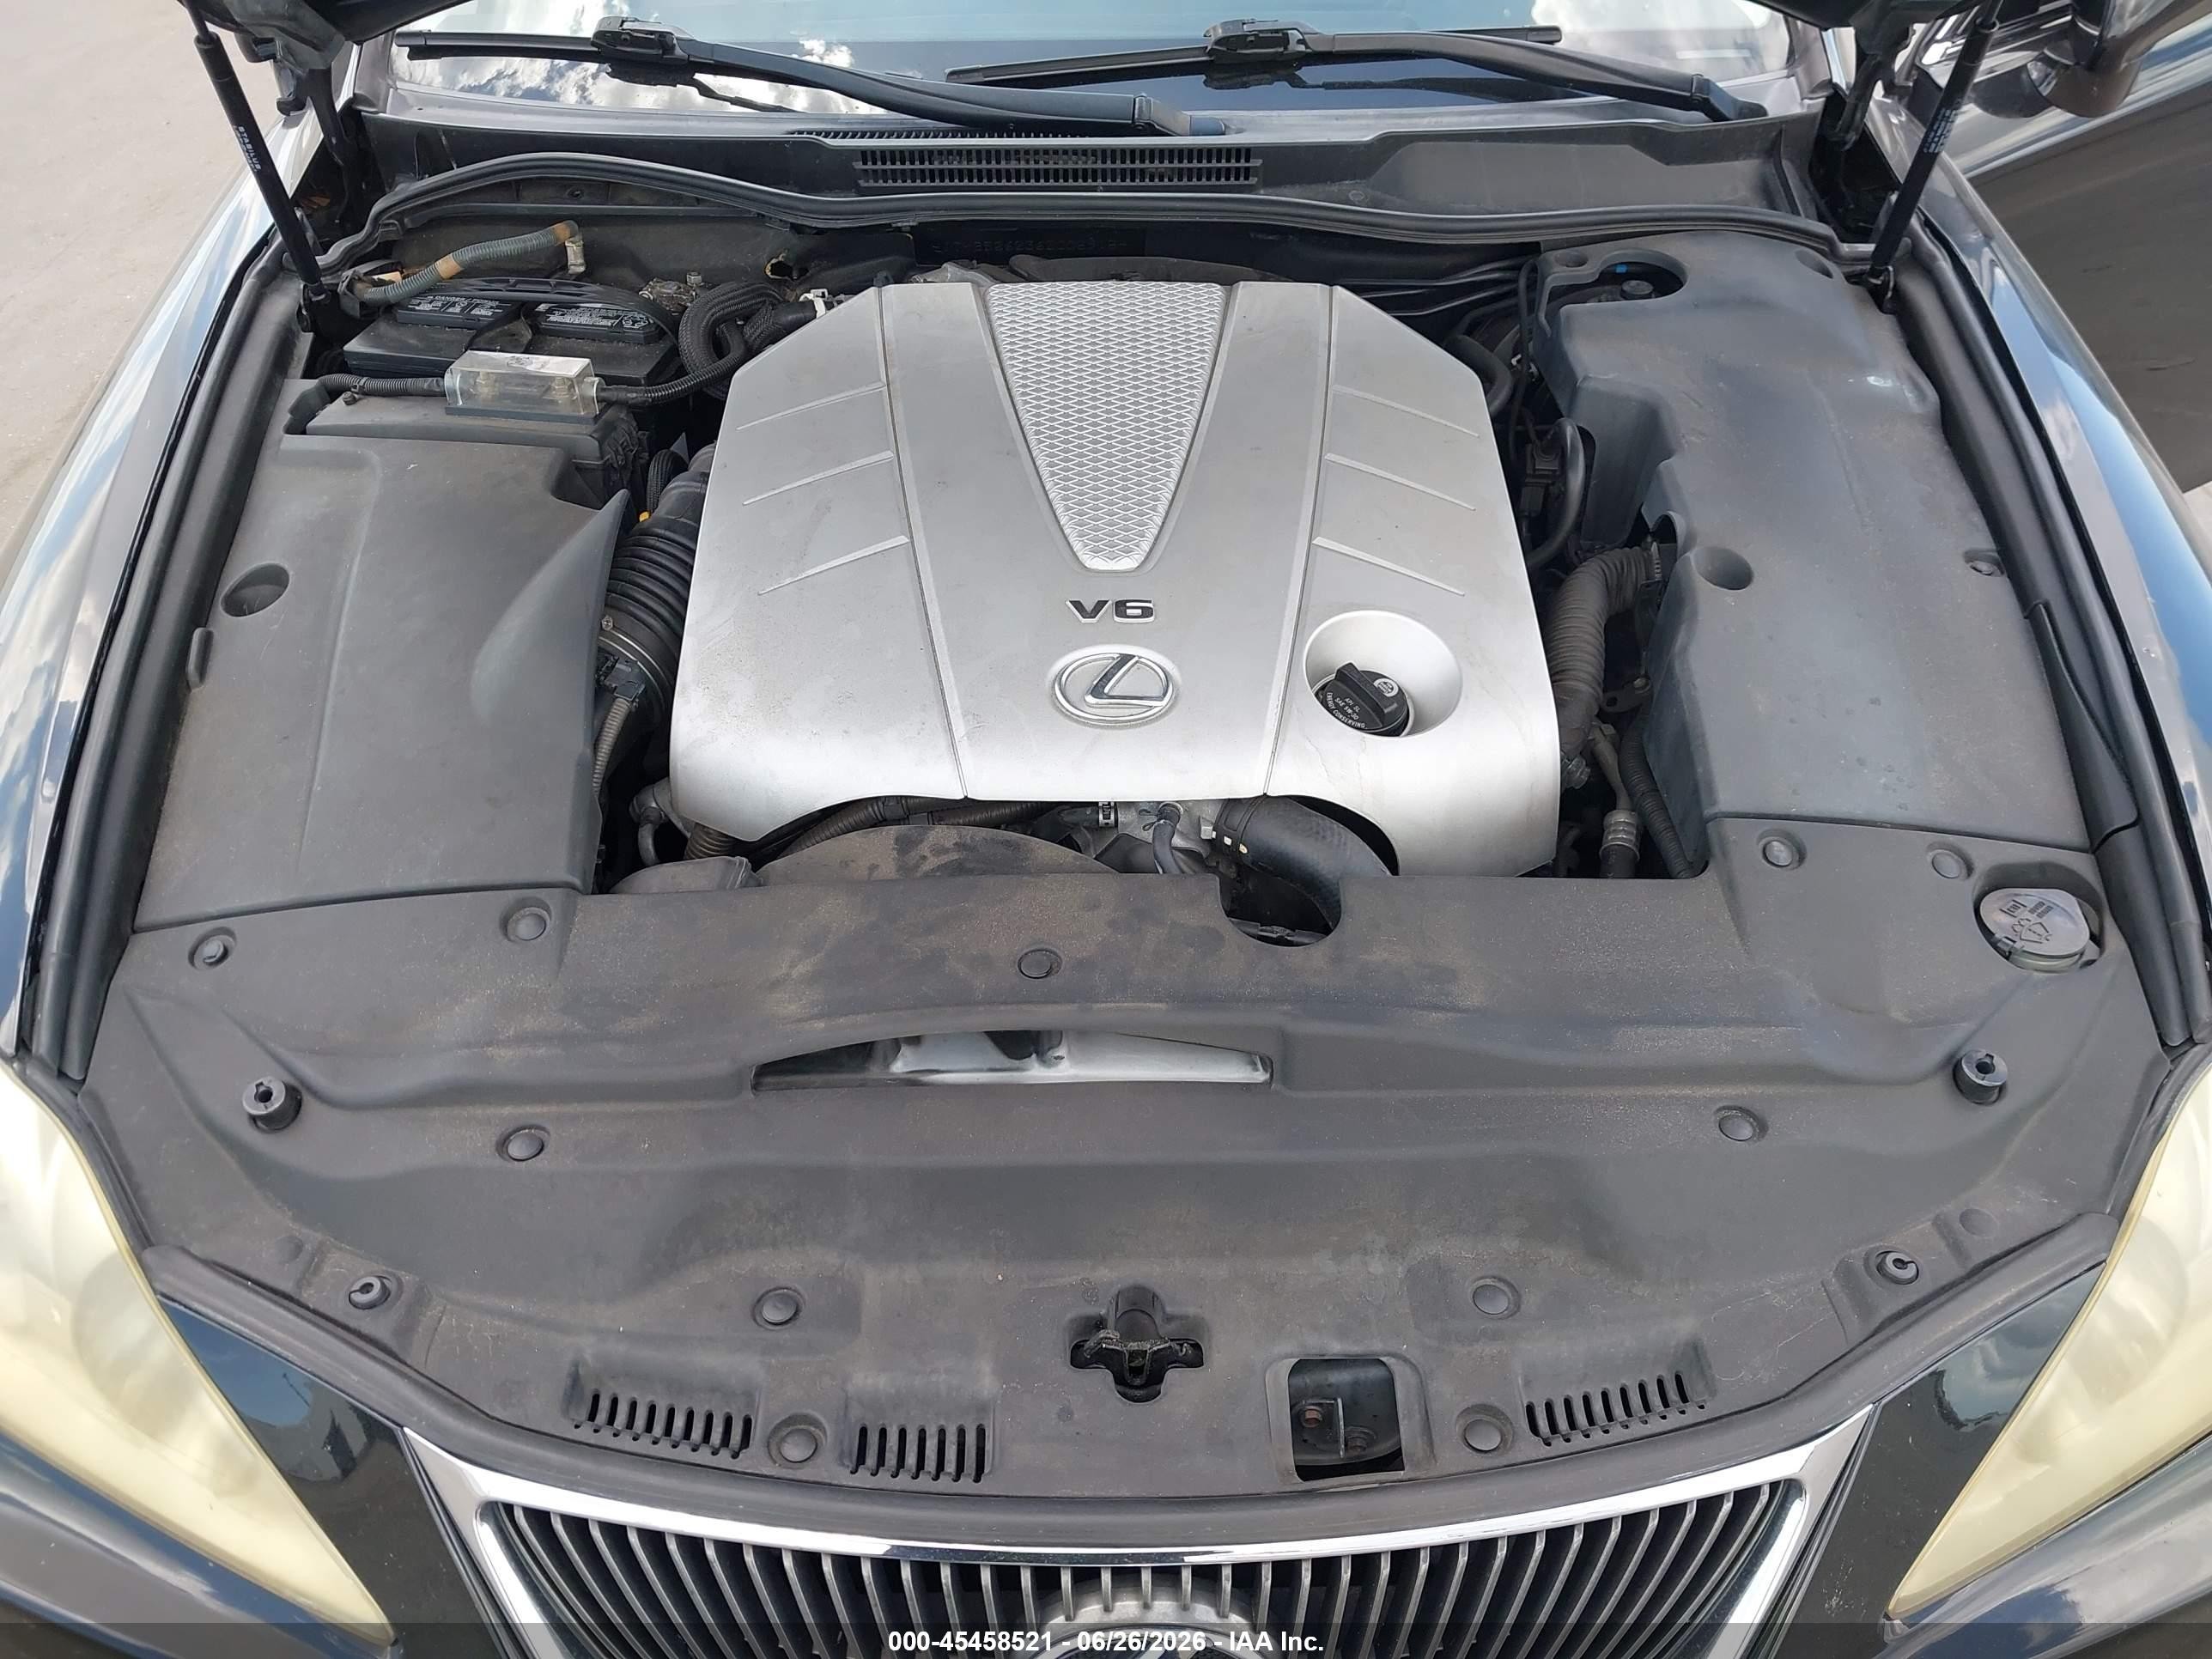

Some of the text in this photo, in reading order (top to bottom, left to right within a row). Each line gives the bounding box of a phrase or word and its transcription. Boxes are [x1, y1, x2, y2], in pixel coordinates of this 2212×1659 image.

[238, 125, 262, 170] STABILUS
[1066, 599, 1155, 623] V6
[1326, 692, 1365, 728] ENERGY CONSERVING
[1334, 697, 1359, 720] SAE 5W-30
